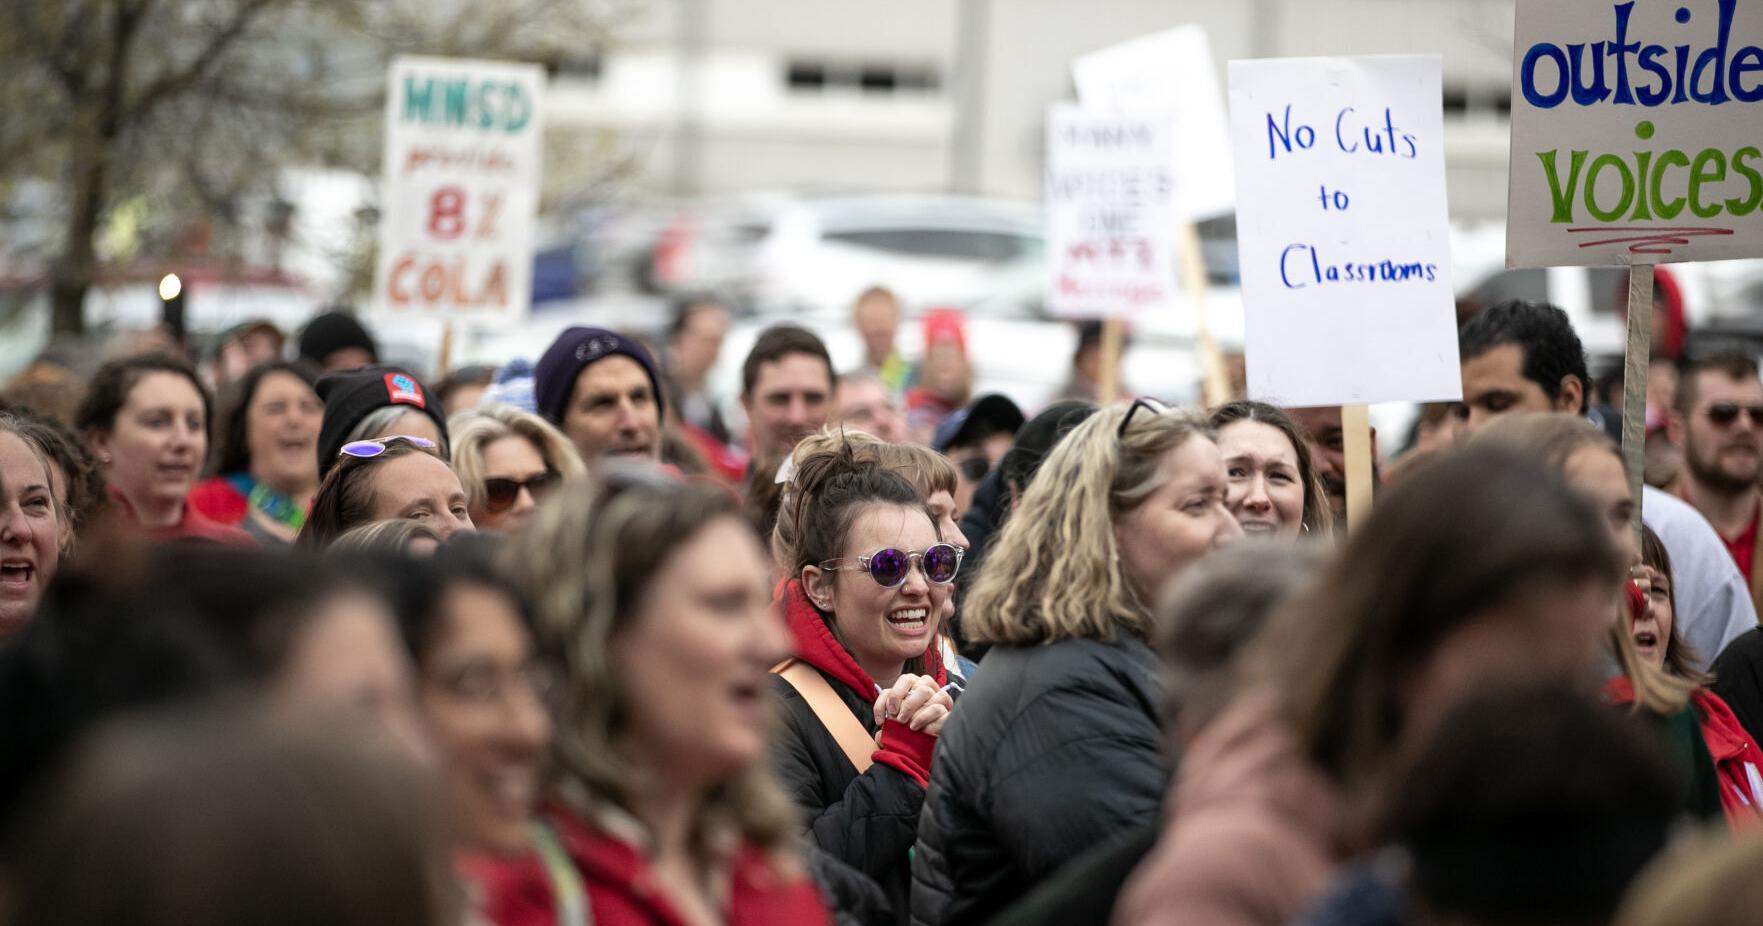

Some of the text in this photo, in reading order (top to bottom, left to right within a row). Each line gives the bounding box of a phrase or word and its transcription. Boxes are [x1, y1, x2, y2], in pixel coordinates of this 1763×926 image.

[1521, 0, 1763, 109] outside
[1266, 104, 1417, 159] No Cuts
[1317, 185, 1350, 211] to
[1535, 120, 1763, 223] voices
[386, 253, 509, 309] COLA
[1280, 243, 1438, 289] Classrooms
